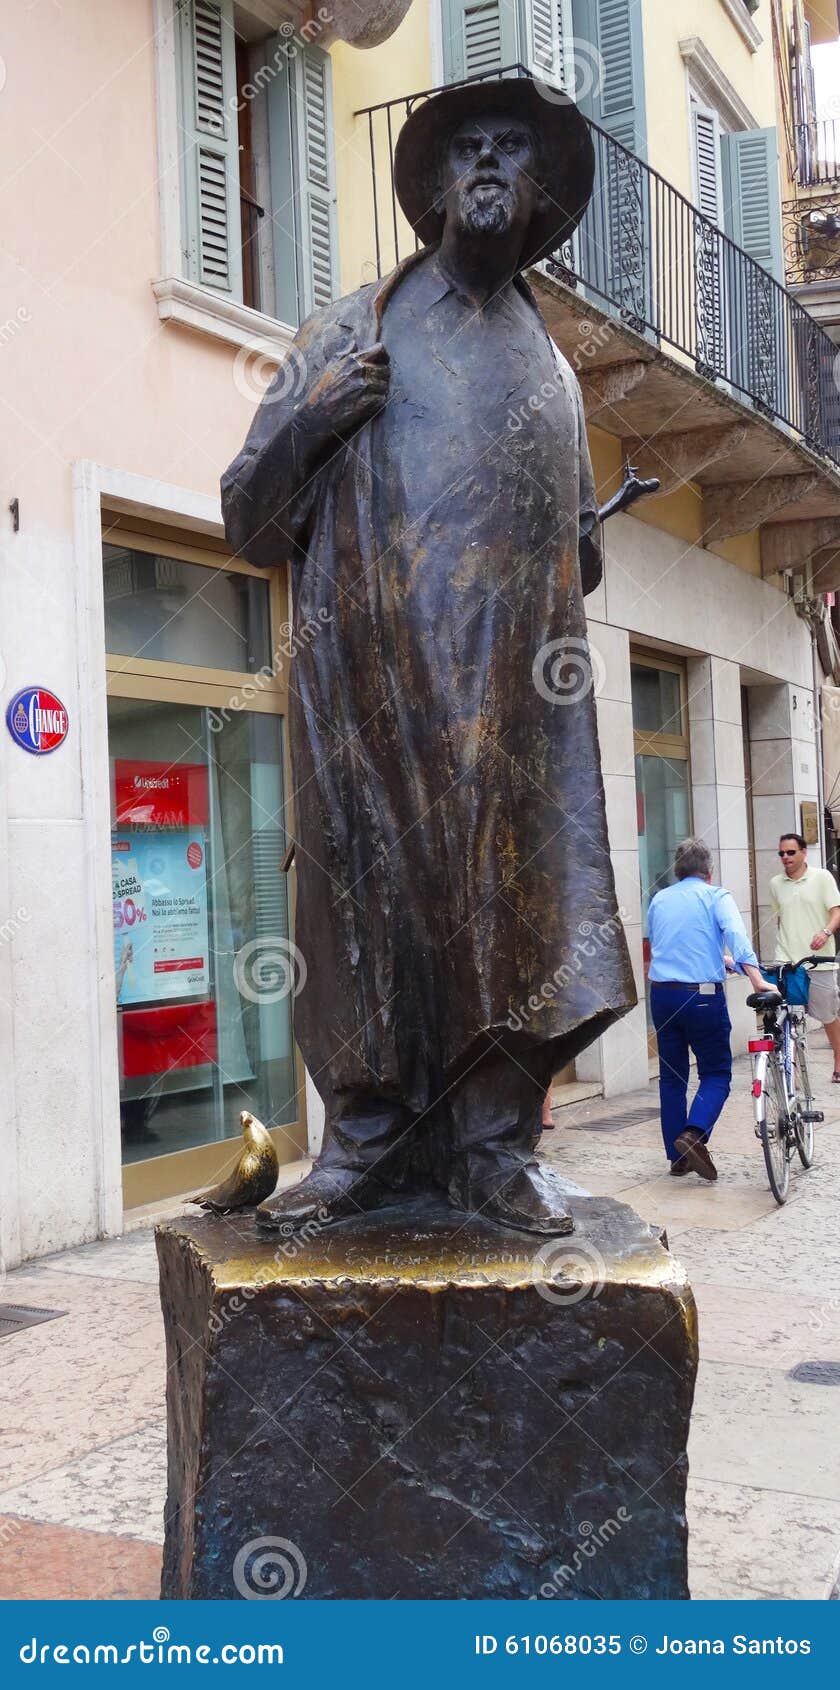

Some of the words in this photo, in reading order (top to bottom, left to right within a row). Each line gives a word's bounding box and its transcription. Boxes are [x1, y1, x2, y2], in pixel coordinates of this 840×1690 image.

[28, 694, 65, 747] CHANGE
[120, 876, 137, 887] CASA
[117, 885, 142, 898] SPREAD
